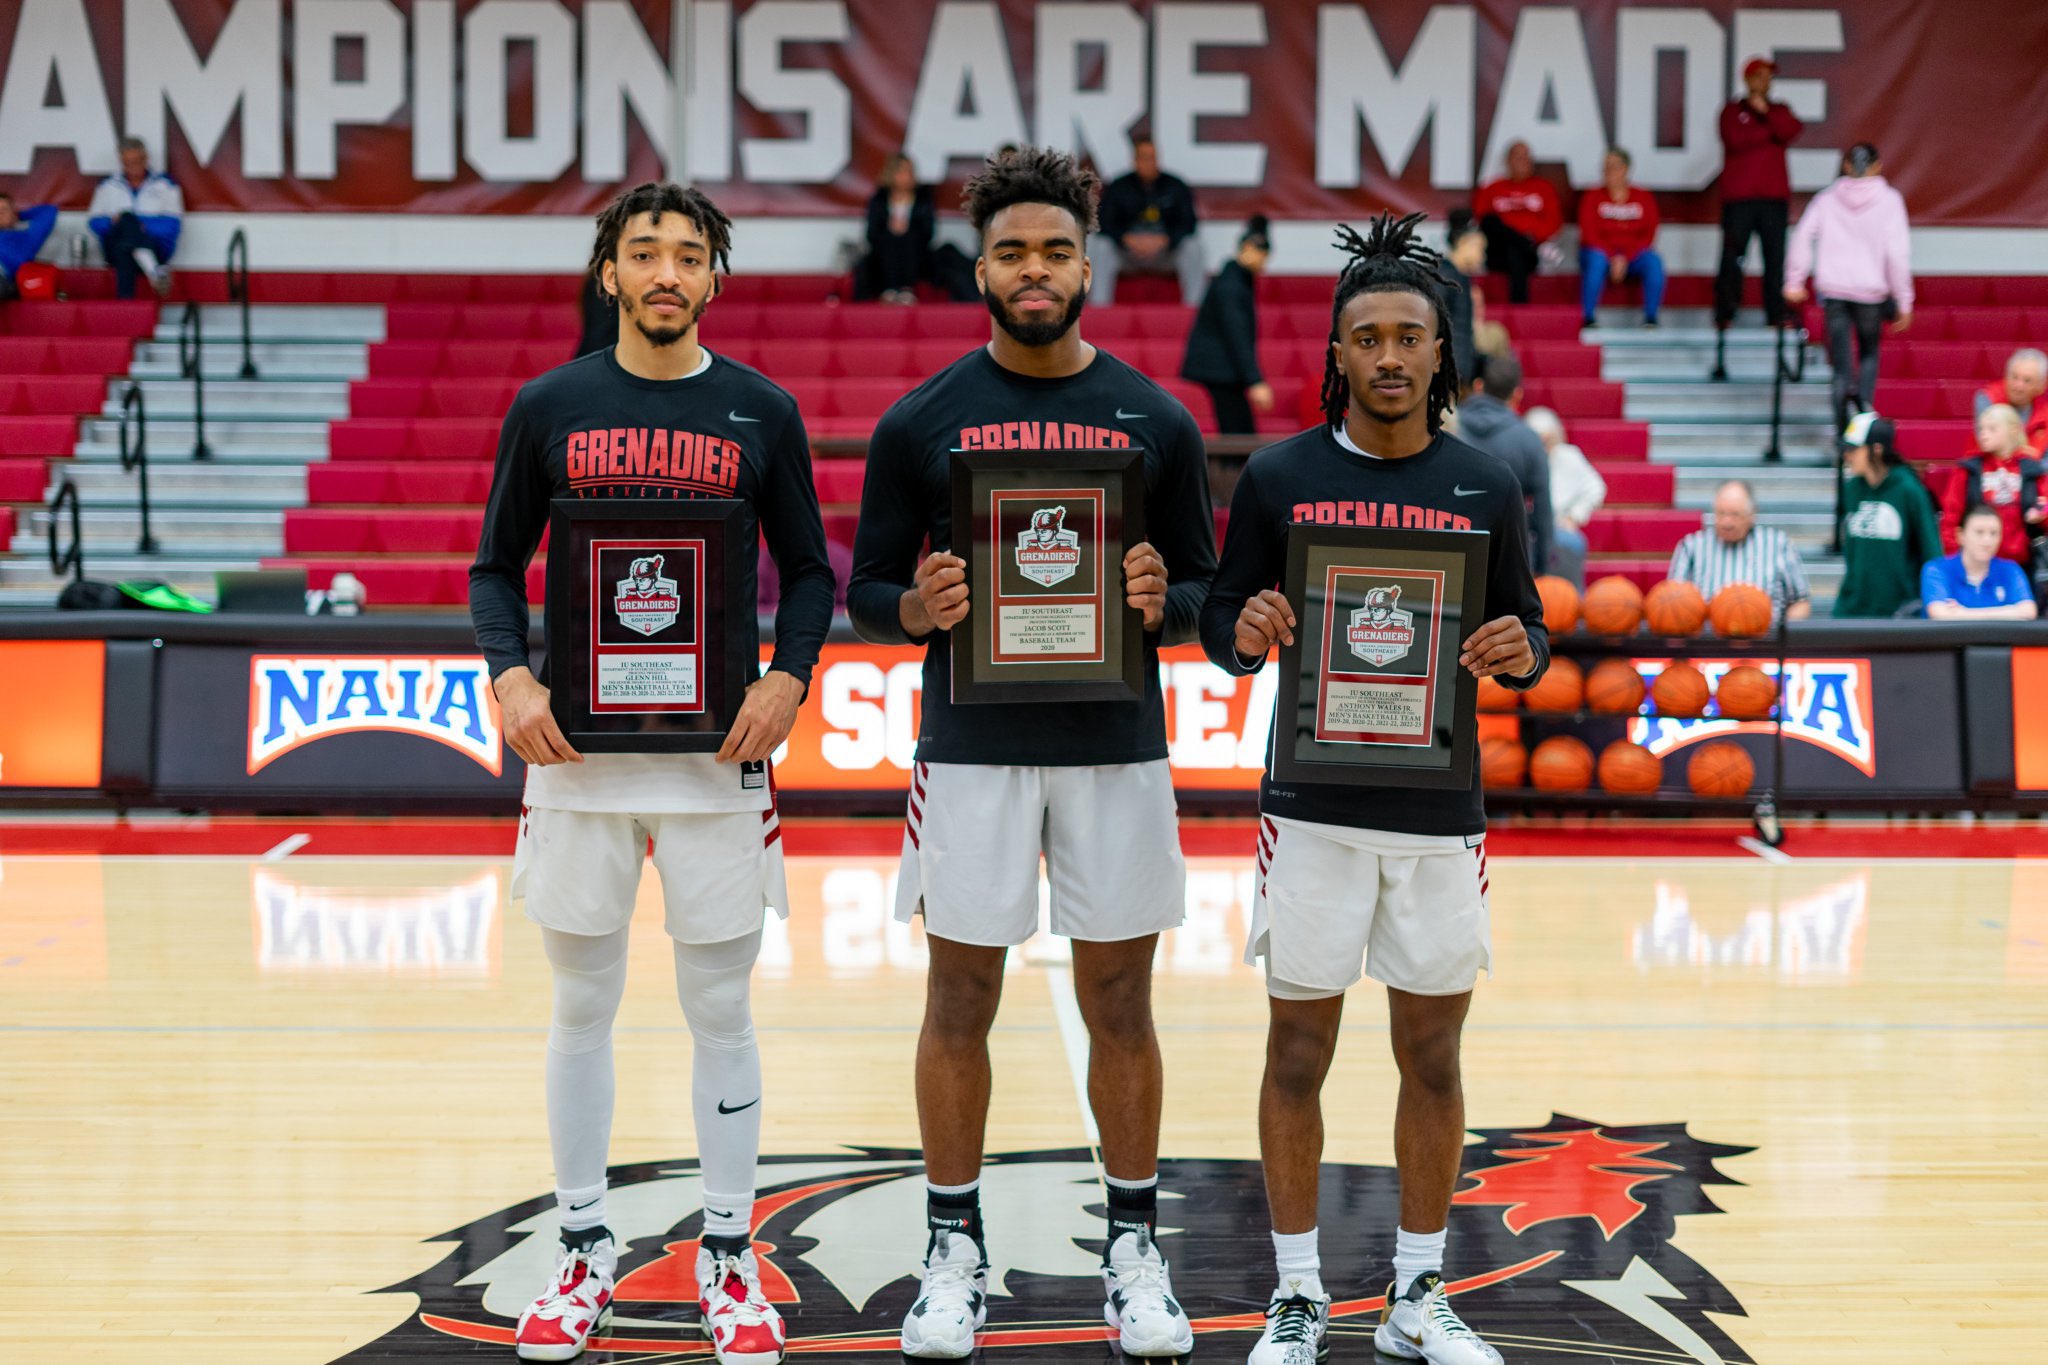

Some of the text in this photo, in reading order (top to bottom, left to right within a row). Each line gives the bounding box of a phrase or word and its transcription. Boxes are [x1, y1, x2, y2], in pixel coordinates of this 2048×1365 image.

[904, 2, 1268, 187] ARE
[1316, 4, 1845, 192] MADE
[567, 428, 742, 489] GRENADIER
[1020, 552, 1076, 561] GRENADIERS
[620, 600, 676, 610] GRENADIERS
[1352, 631, 1409, 641] GRENADIERS
[1360, 690, 1403, 698] SOUTHEAST
[263, 669, 487, 745] NAIA
[1353, 713, 1398, 721] BASKETBALL
